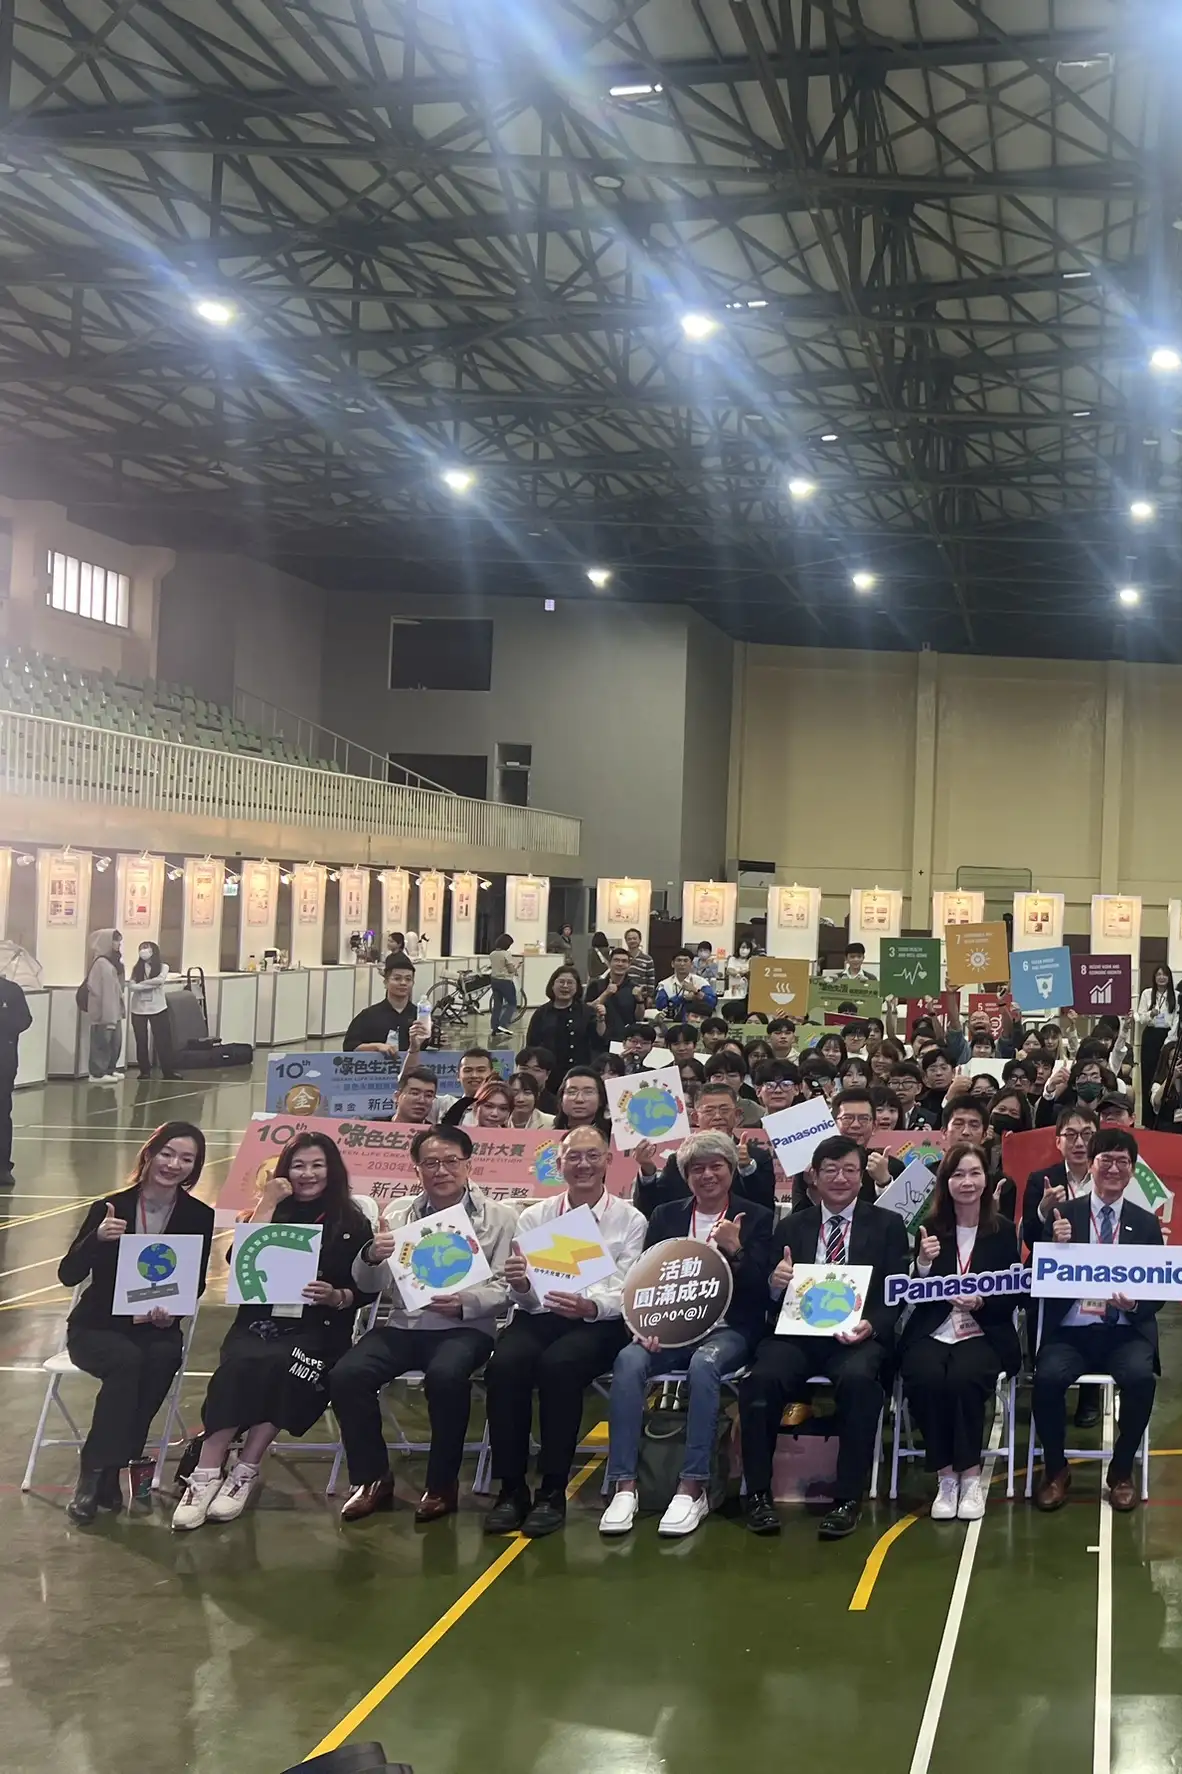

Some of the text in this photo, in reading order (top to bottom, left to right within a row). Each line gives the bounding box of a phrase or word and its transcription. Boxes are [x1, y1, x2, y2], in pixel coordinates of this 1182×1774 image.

[888, 946, 896, 958] 3
[764, 967, 771, 977] 2
[1022, 960, 1029, 972] 6
[1080, 964, 1087, 975] 8
[916, 998, 923, 1008] 4
[977, 1002, 983, 1011] 5
[275, 1060, 310, 1079] 10th
[291, 1087, 316, 1109] 金
[367, 1098, 400, 1111] 新台
[257, 1122, 308, 1145] 10th
[337, 1123, 414, 1150] 綠色生
[772, 1118, 836, 1149] Panasonic
[658, 1256, 703, 1282] 活動
[632, 1277, 721, 1311] 圓滿成功
[888, 1266, 1033, 1303] Panasonic
[288, 1362, 310, 1382] AND
